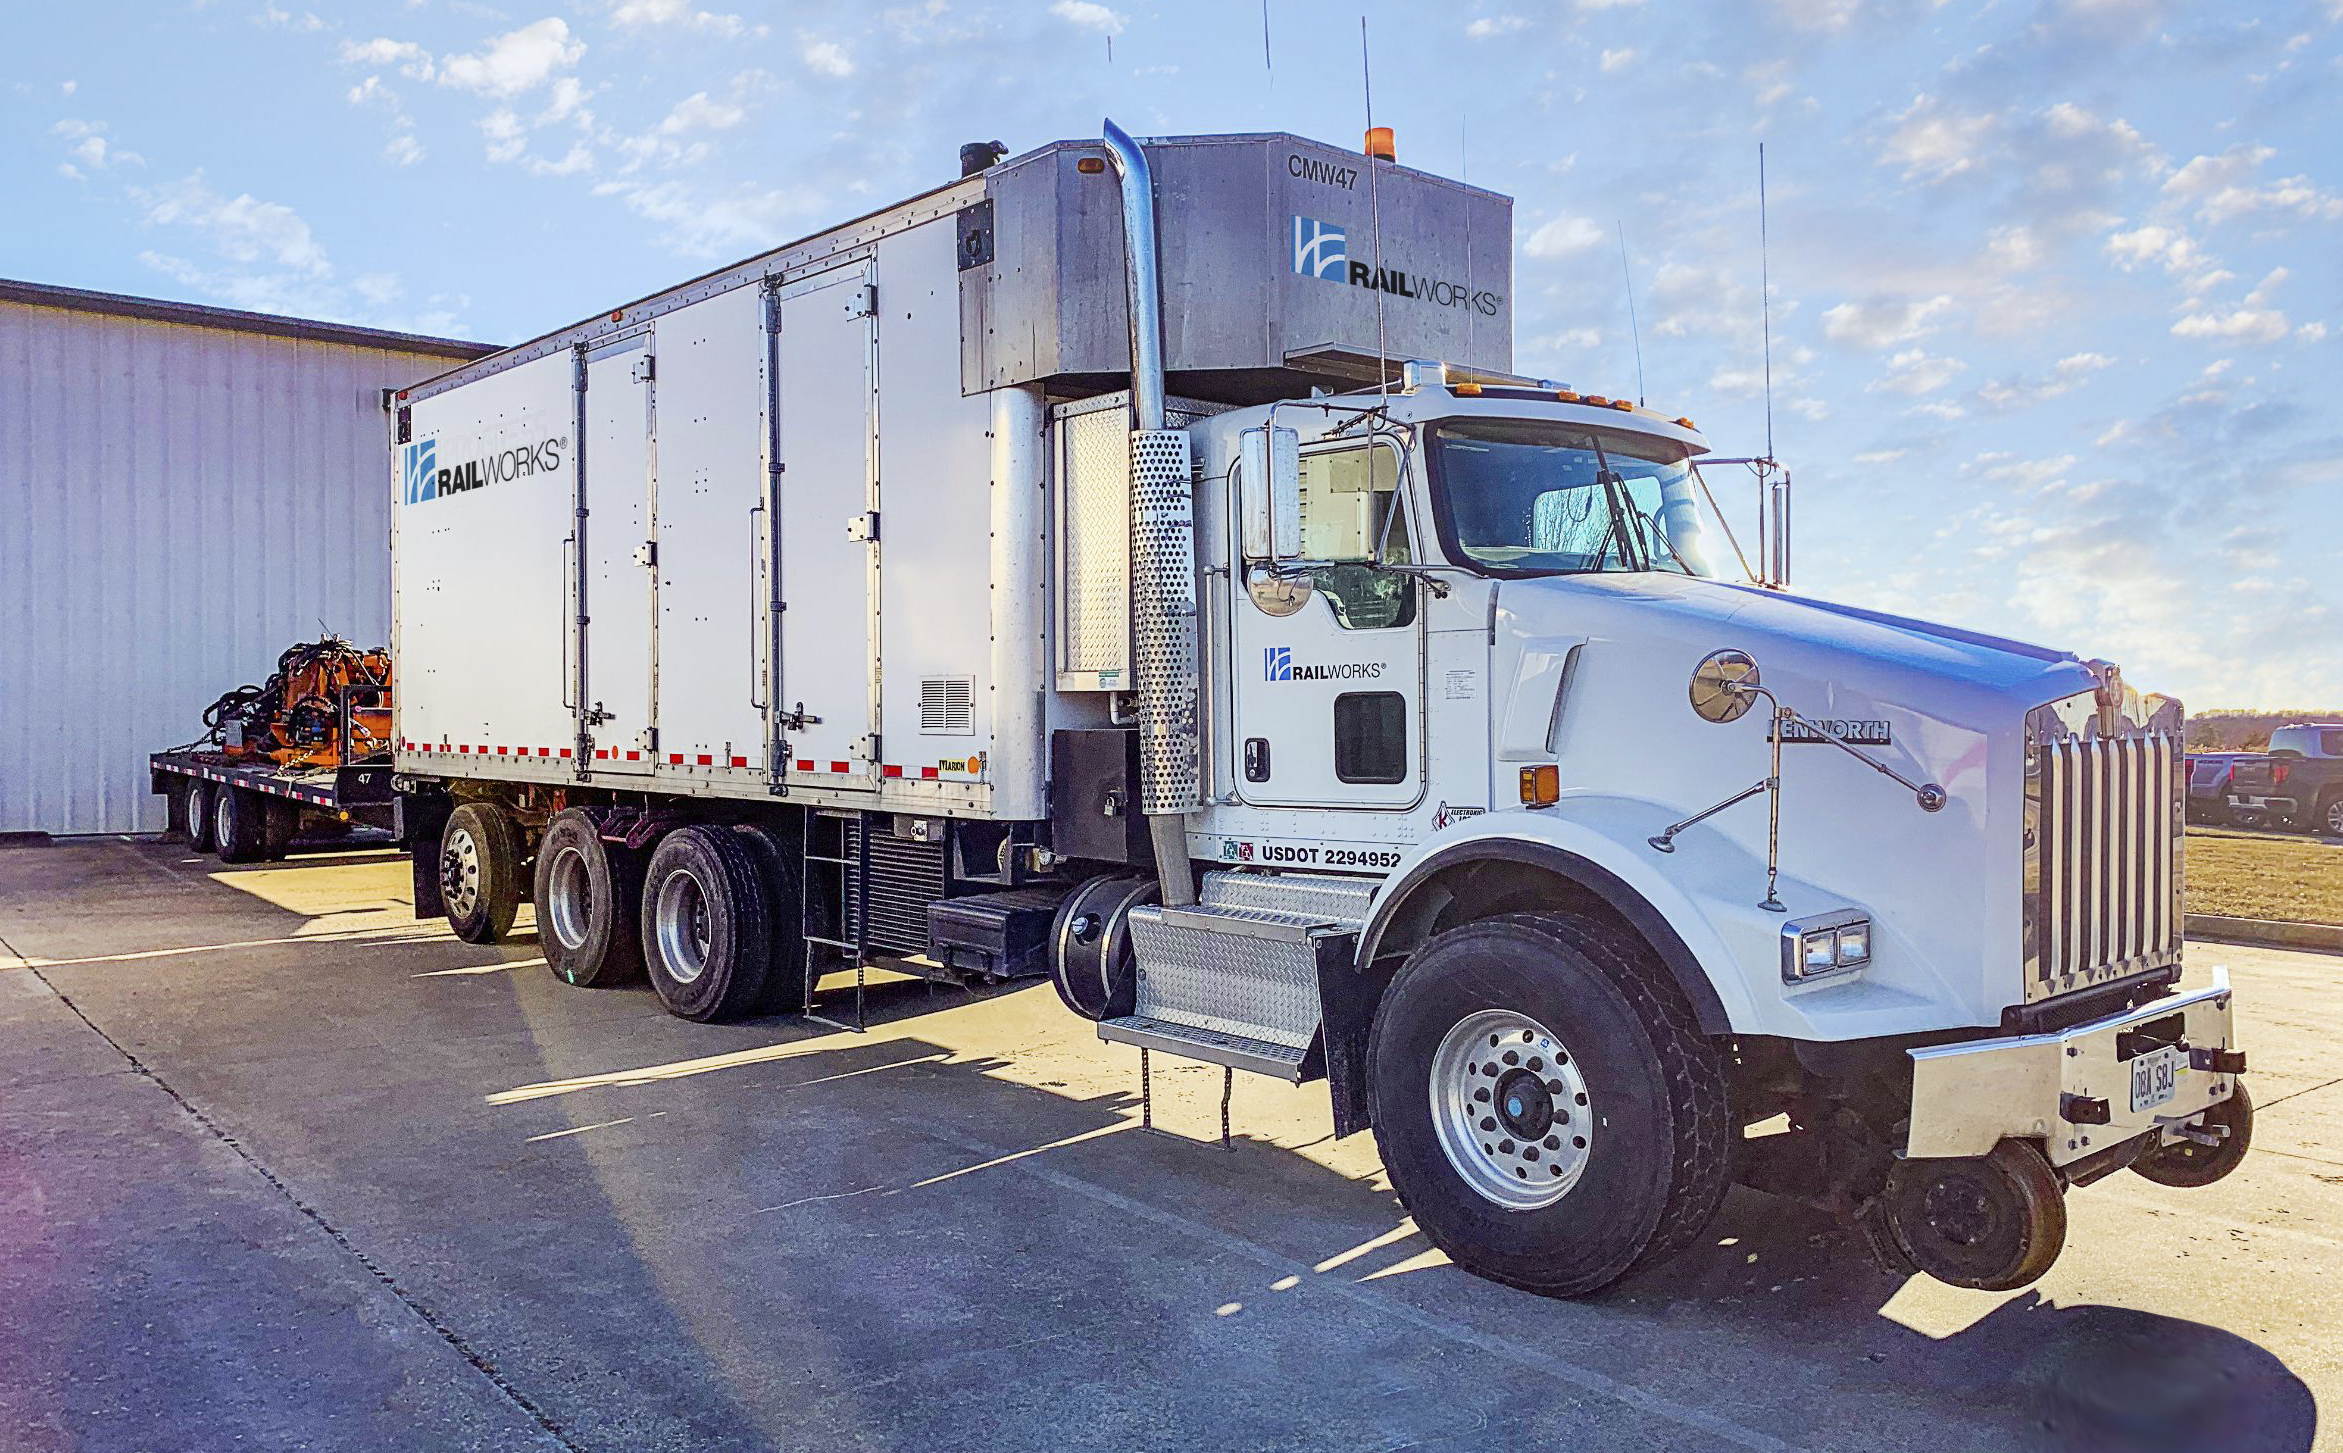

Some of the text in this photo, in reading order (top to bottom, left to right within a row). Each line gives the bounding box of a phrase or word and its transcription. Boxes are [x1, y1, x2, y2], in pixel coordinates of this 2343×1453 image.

[1288, 154, 1358, 191] CMW47
[358, 773, 371, 784] 47
[1262, 845, 1319, 863] USDOT
[1324, 849, 1401, 868] 2294952
